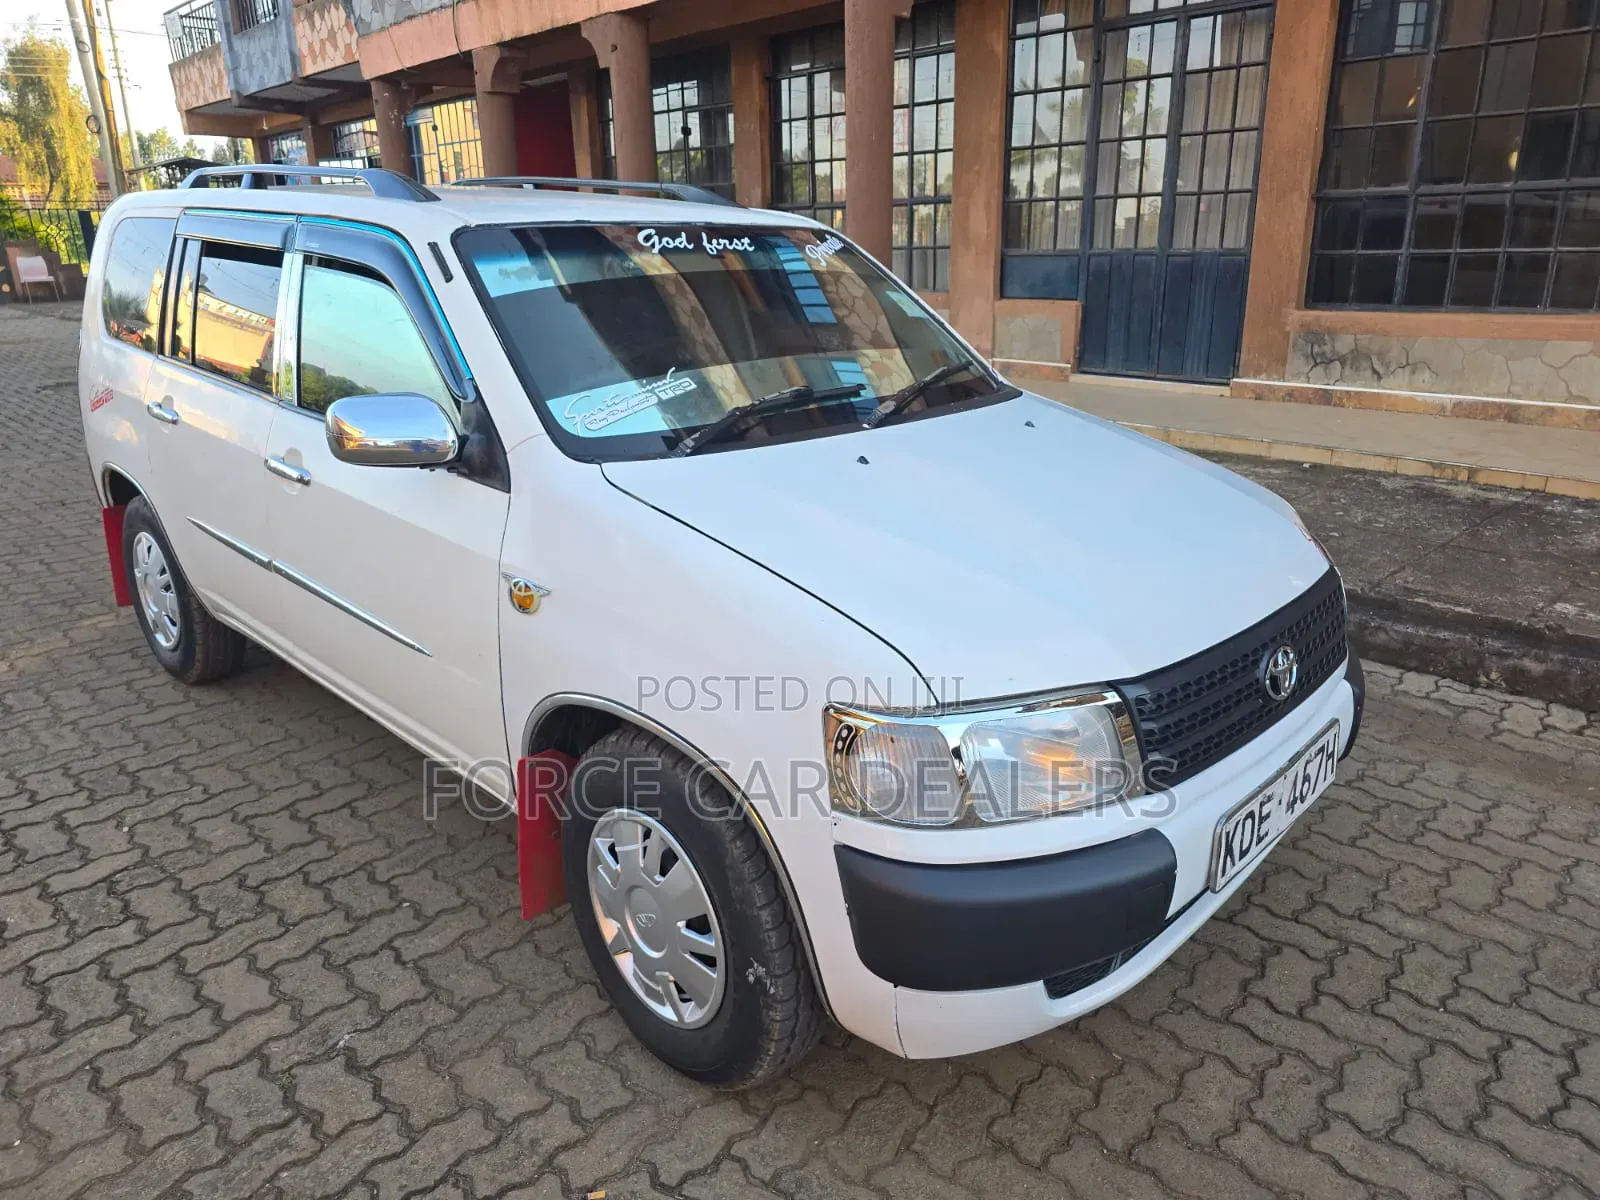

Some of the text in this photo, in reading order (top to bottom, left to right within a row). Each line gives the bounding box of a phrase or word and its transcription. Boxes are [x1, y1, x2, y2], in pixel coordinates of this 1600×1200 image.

[637, 228, 694, 255] God
[1221, 731, 1337, 877] KDE 467H
